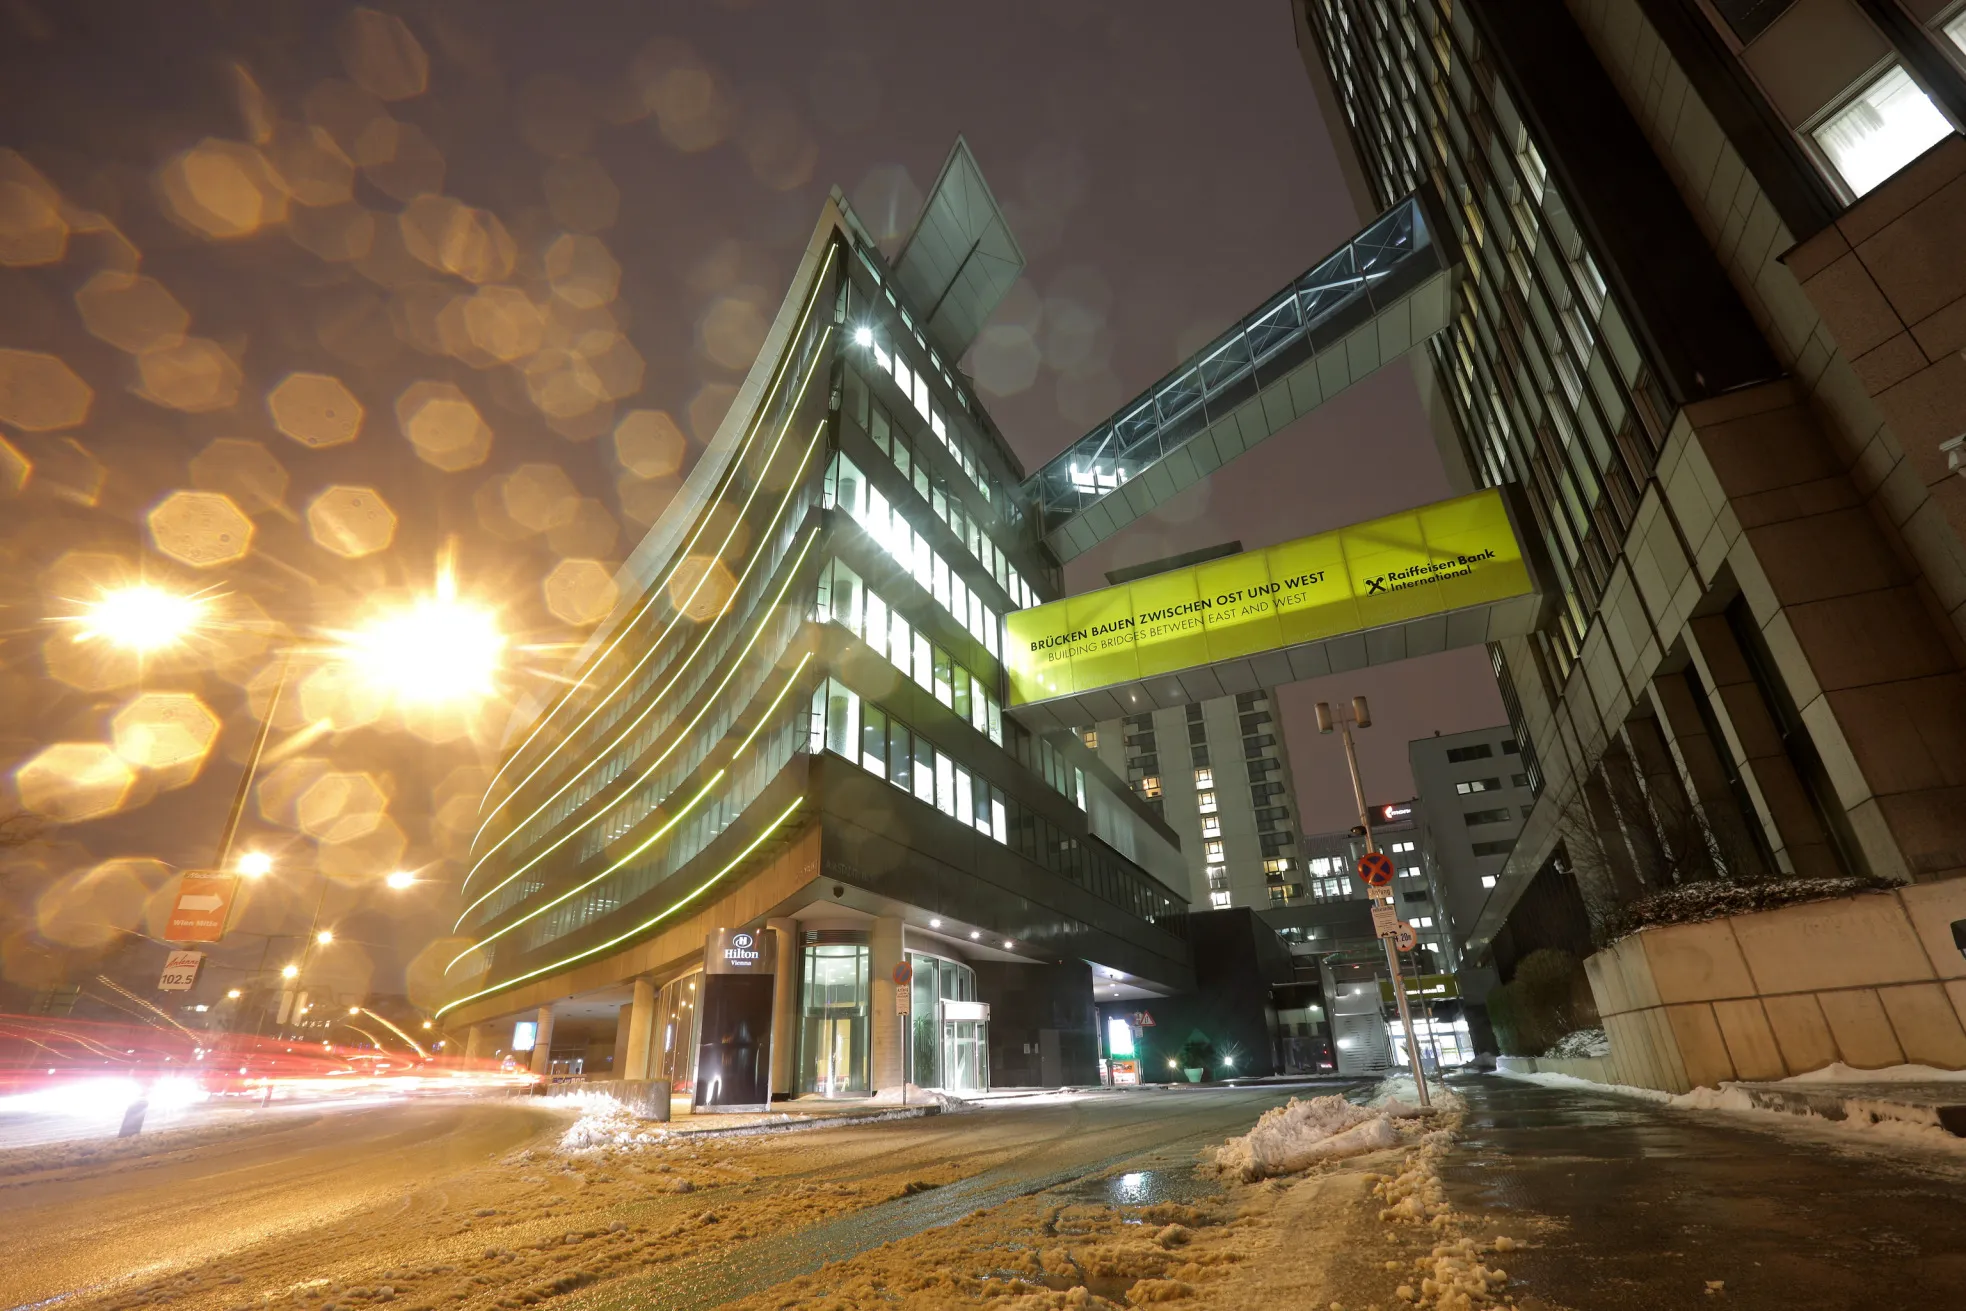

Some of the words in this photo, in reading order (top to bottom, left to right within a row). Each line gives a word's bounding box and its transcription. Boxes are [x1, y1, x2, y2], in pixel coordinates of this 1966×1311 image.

[1388, 560, 1456, 581] Raiffeisen
[1457, 549, 1495, 566] Bank
[1390, 565, 1472, 591] International
[1030, 629, 1088, 652] BRÜCKEN
[1092, 617, 1135, 637] BAUEN
[1140, 599, 1212, 625] ZWISCHEN
[1216, 591, 1243, 606] OST
[1248, 583, 1280, 598] UND
[1285, 571, 1325, 589] WEST
[1048, 642, 1098, 662] BUILDING
[1101, 631, 1146, 649] BRIDGES
[1150, 616, 1204, 637] BETWEEN
[1208, 609, 1236, 624] EAST
[1241, 601, 1269, 616] AND
[1273, 592, 1307, 608] WEST
[173, 919, 195, 927] Wien
[196, 919, 218, 927] Mitte
[167, 954, 199, 969] Antenne
[724, 948, 759, 959] Hilton
[161, 974, 193, 985] 102.5
